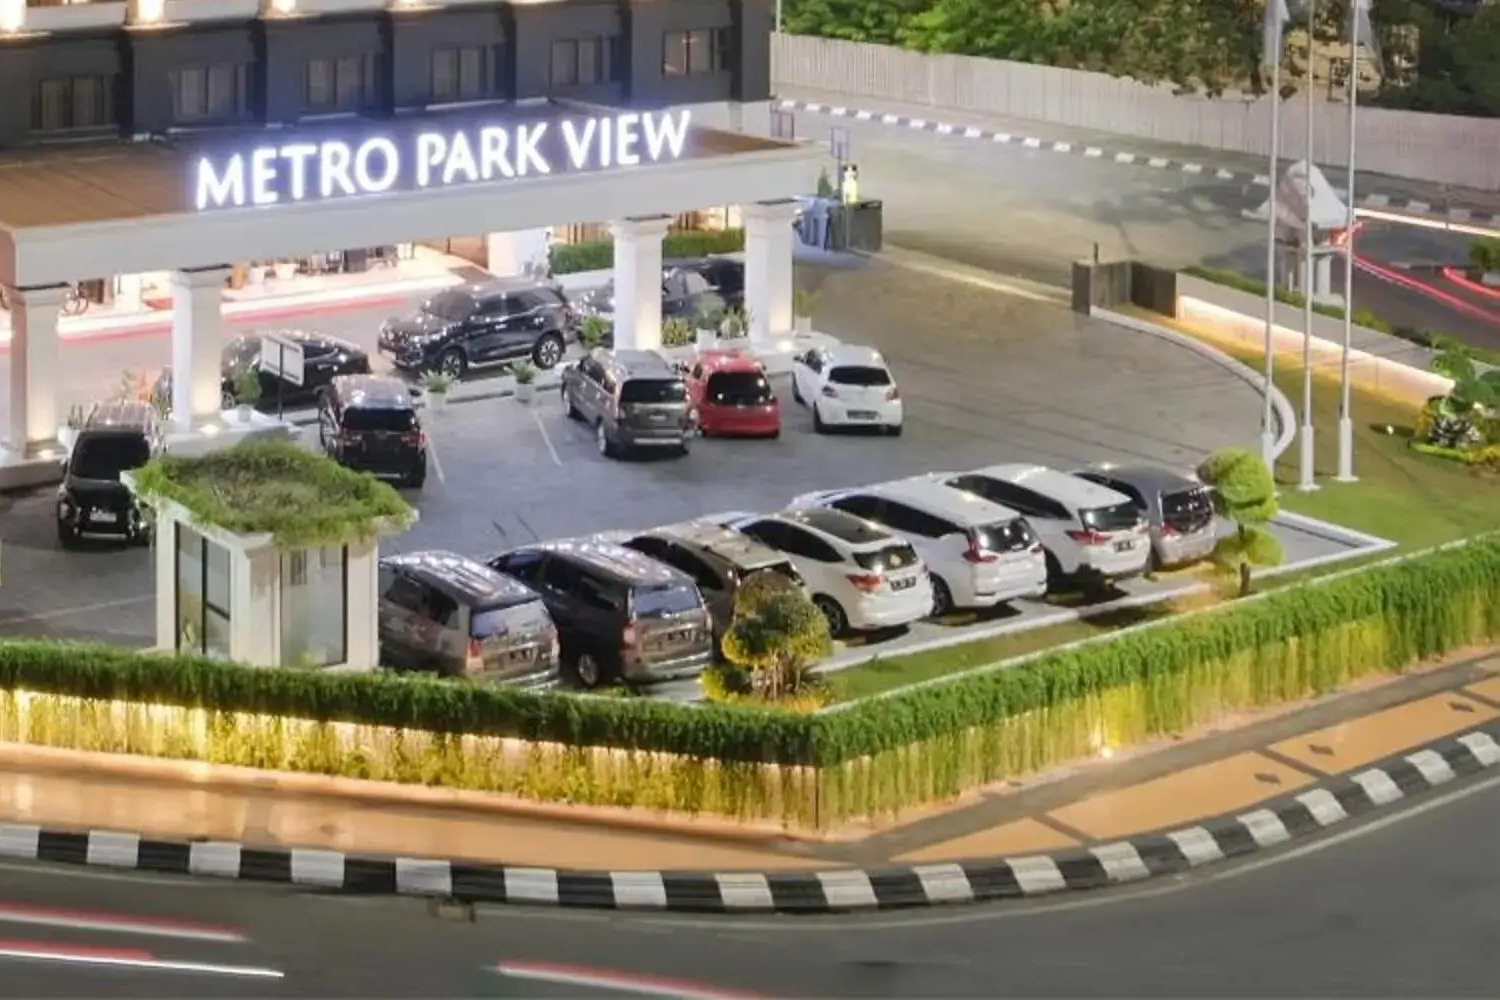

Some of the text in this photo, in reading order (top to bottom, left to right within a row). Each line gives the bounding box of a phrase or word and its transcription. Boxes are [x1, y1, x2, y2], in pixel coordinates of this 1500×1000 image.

[195, 110, 691, 209] METRO PARK VIEW
